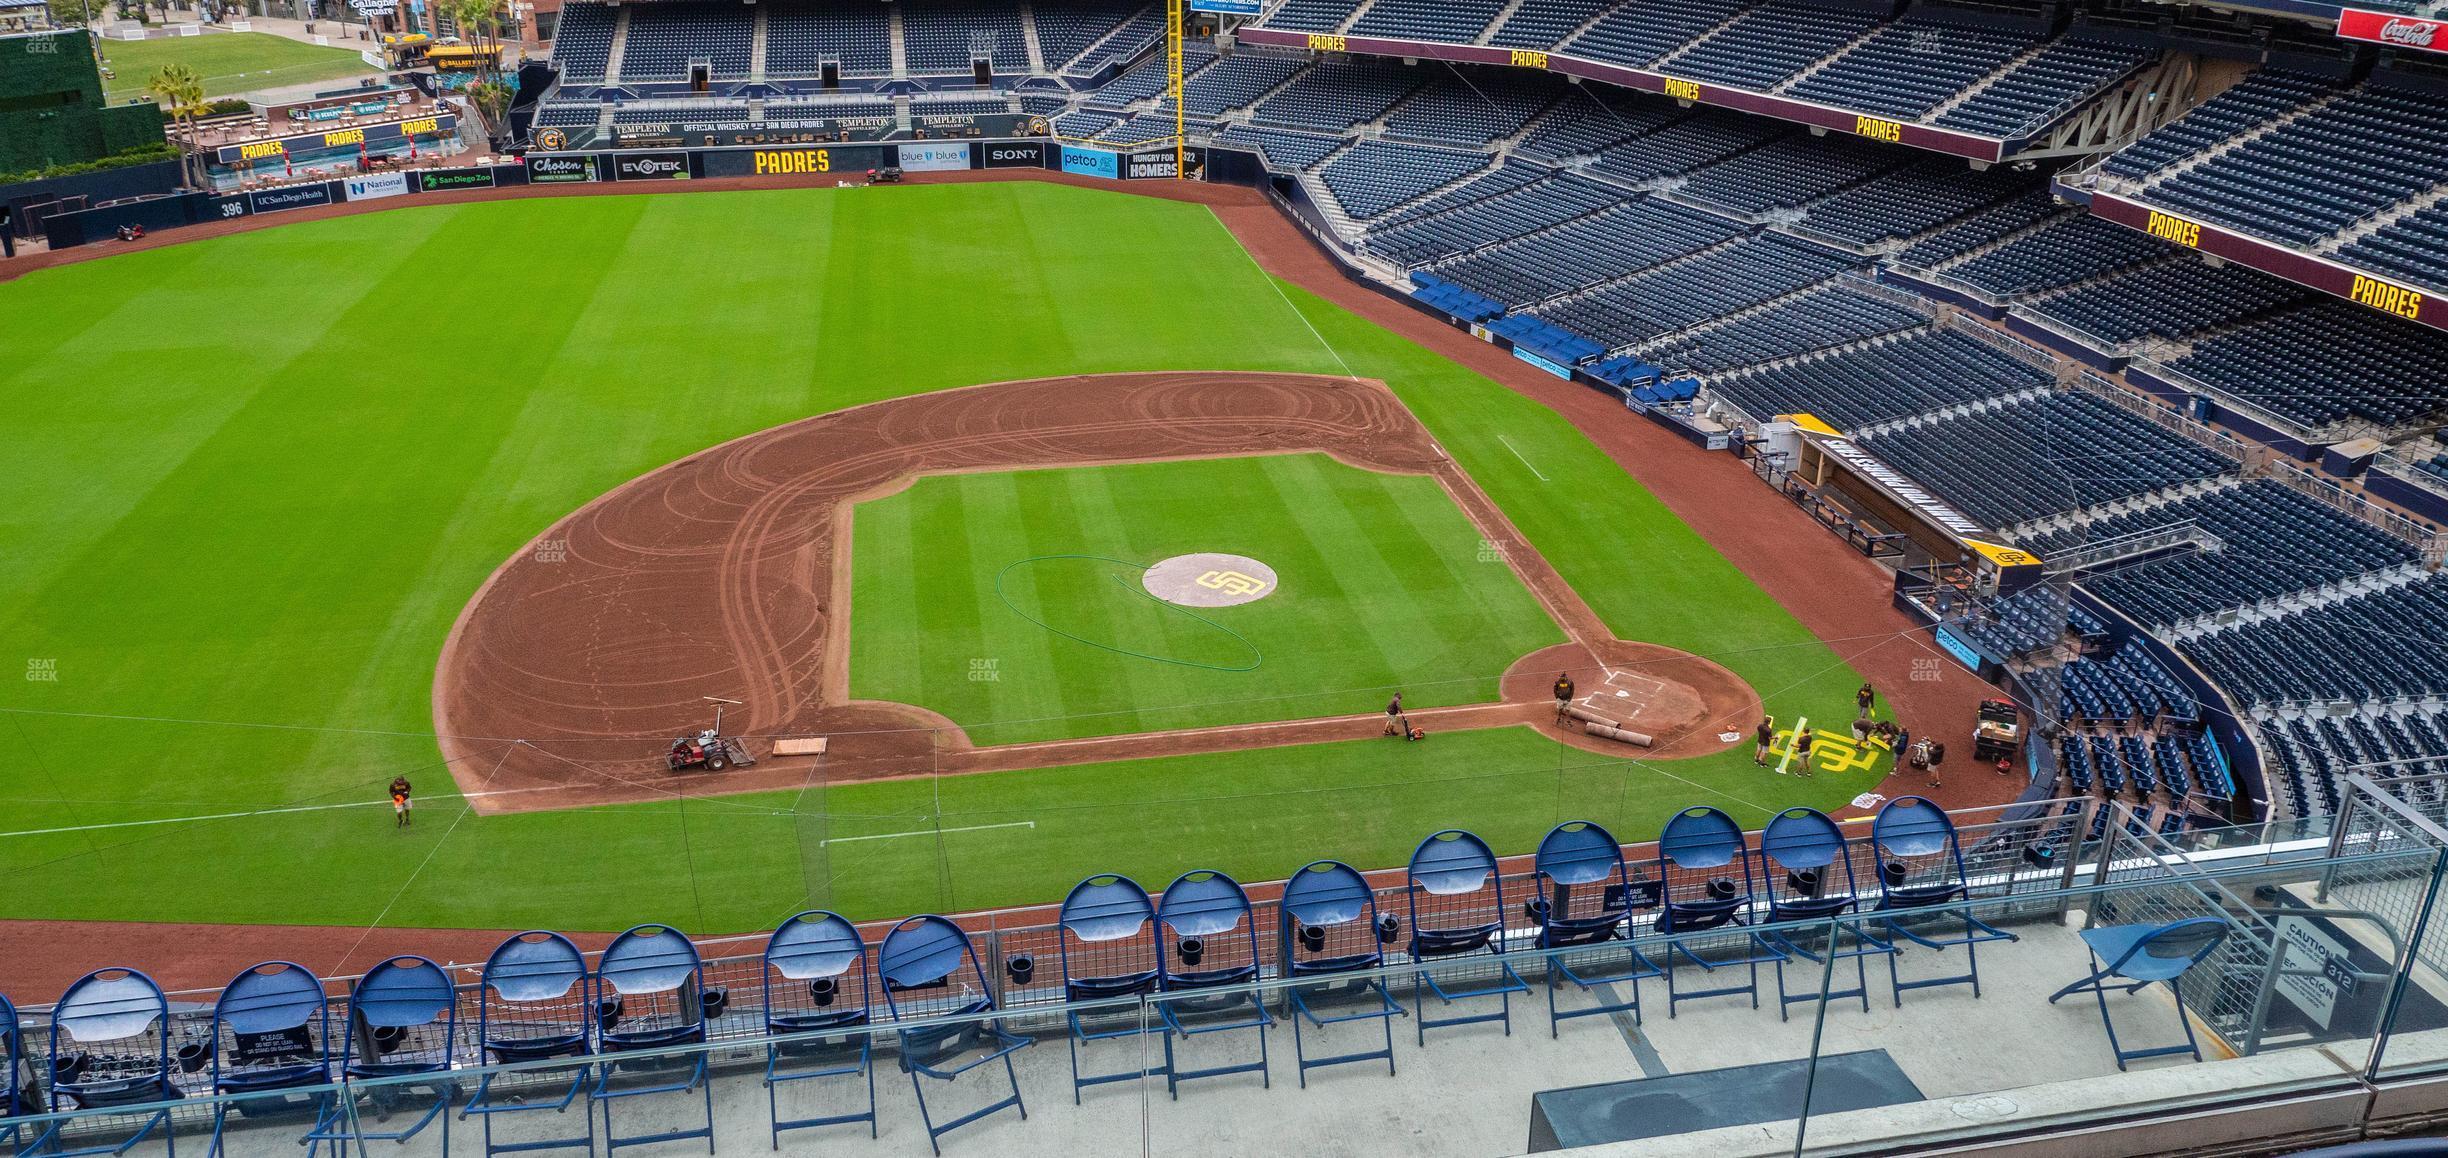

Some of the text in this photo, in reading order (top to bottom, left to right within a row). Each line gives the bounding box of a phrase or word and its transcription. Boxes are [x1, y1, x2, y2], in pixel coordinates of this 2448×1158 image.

[360, 8, 393, 17] Square
[1308, 34, 1346, 51] PADRES
[1511, 50, 1548, 69] PADRES
[1665, 78, 1700, 100] PADRES
[401, 118, 438, 136] PADRES
[684, 123, 716, 132] OFFICIAL
[716, 122, 750, 131] WHISKEY
[766, 121, 780, 129] SAN
[780, 121, 799, 129] DIEGO
[800, 120, 825, 129] PADRES
[836, 118, 889, 128] TEMPLETON
[922, 116, 974, 125] TEMPLETON
[615, 124, 670, 134] TEMPLETON
[1856, 116, 1901, 142] PADRES
[324, 129, 365, 147] PADRES
[241, 141, 284, 160] PADRES
[901, 151, 923, 161] blue
[936, 151, 957, 160] blue
[992, 150, 1038, 160] SONY
[1132, 153, 1174, 163] HUNGRY FOR
[534, 158, 581, 171] Chosen
[754, 150, 830, 174] PADRES
[1064, 153, 1097, 168] petco
[1130, 162, 1178, 177] HOMERS
[367, 178, 403, 189] National
[439, 174, 491, 184] San Diego Zoo
[258, 190, 323, 206] UC San Diego Health
[221, 201, 243, 217] 396
[2147, 210, 2201, 248] PADRES
[2351, 274, 2421, 320] PADRES
[1938, 631, 1958, 650] petco
[2289, 923, 2334, 959] CAUTION
[2328, 964, 2352, 989] 312
[260, 1033, 285, 1041] PLEASE
